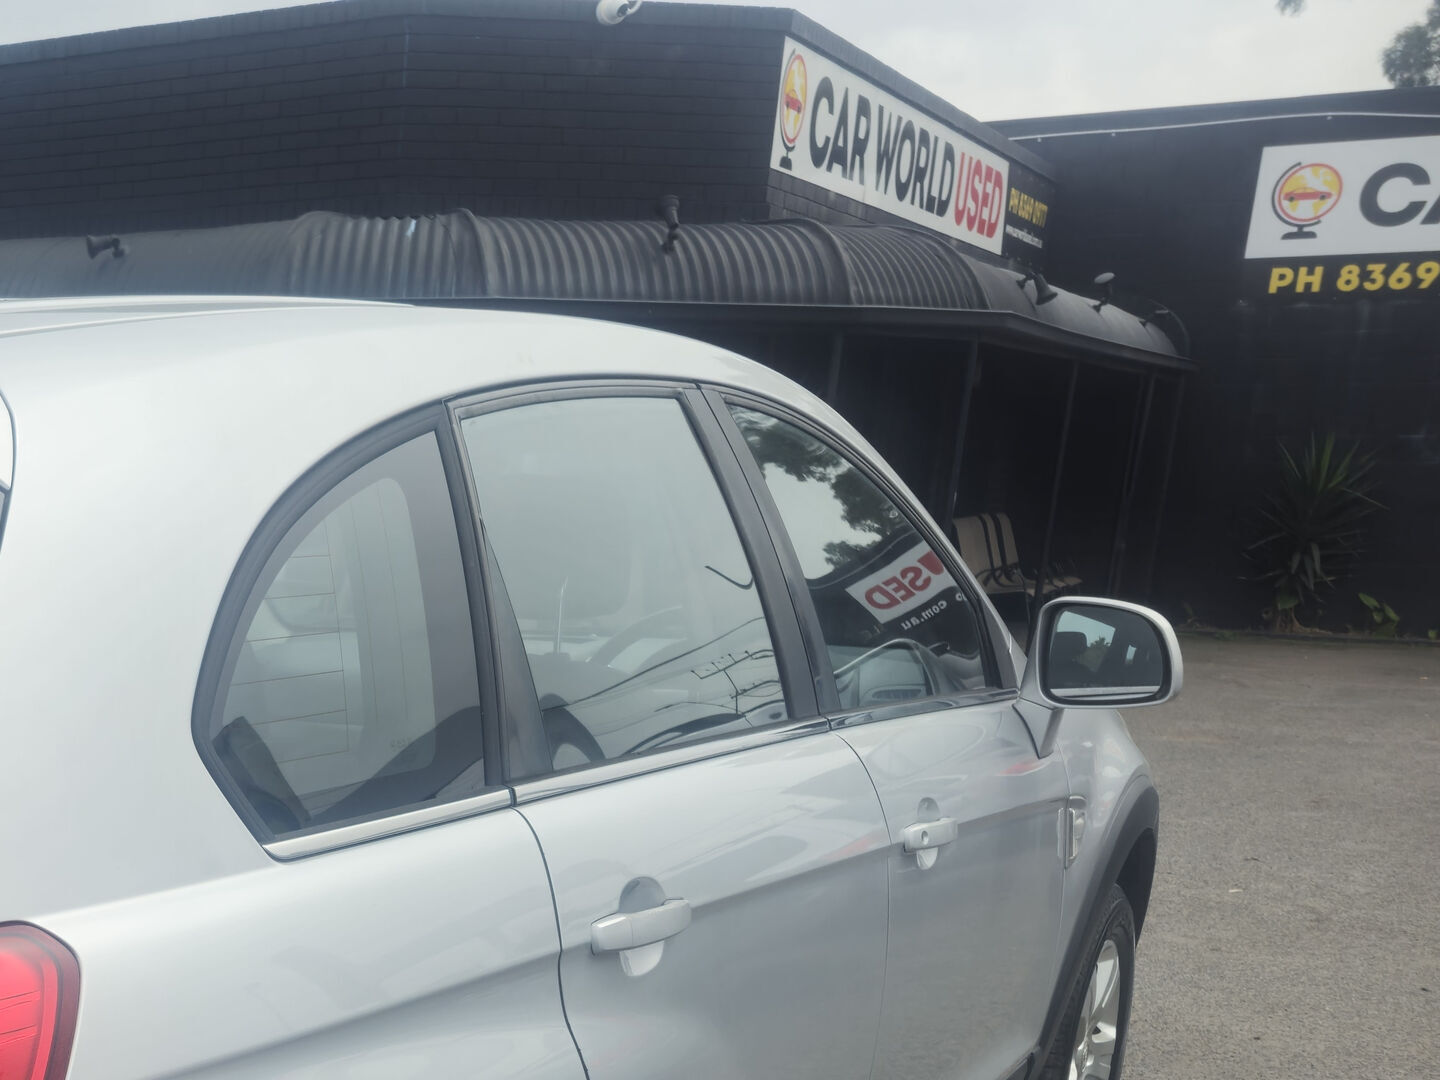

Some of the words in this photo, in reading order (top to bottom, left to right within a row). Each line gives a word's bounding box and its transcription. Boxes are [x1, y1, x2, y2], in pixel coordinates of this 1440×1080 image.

[809, 76, 872, 185] CAR
[875, 103, 955, 218] WORLD
[954, 151, 1004, 239] USED
[1359, 162, 1440, 228] C
[1268, 266, 1324, 294] PH
[1336, 261, 1440, 292] 8369
